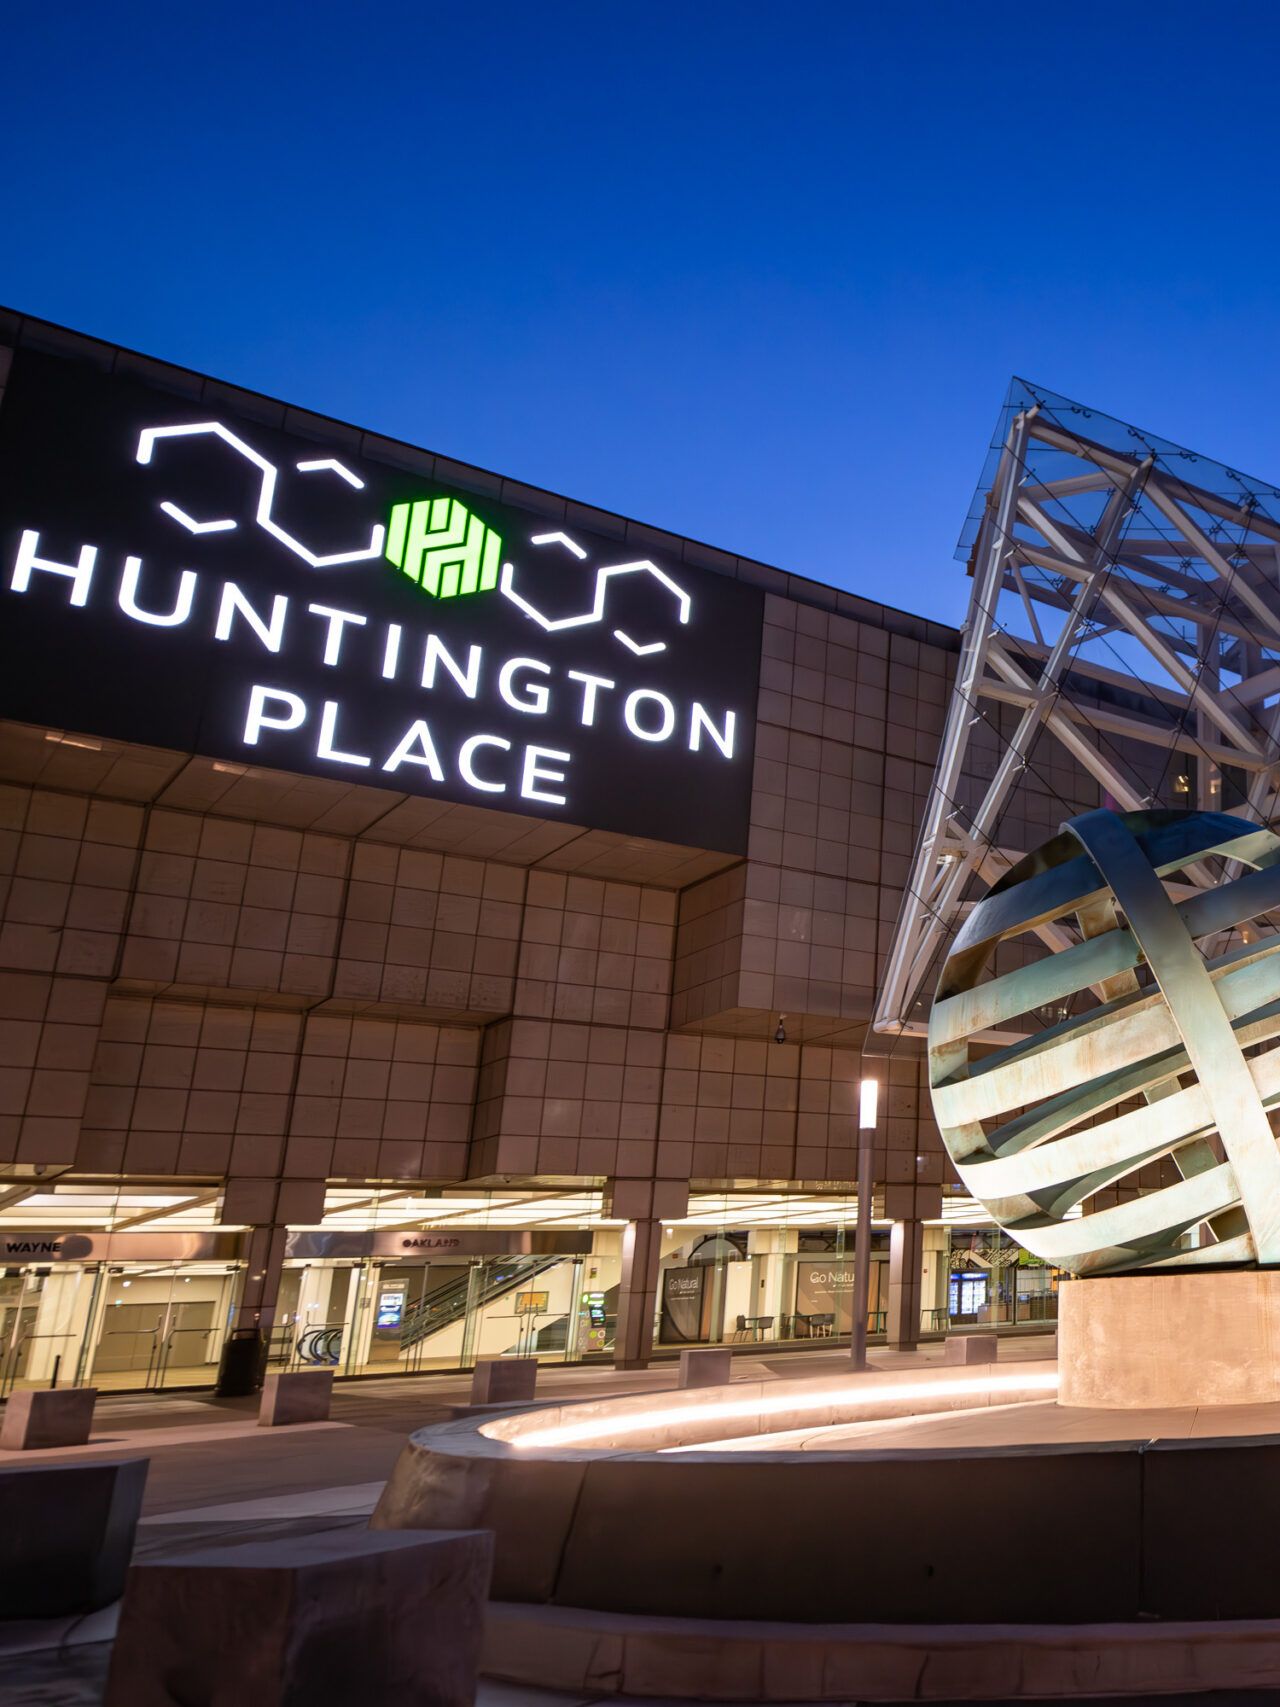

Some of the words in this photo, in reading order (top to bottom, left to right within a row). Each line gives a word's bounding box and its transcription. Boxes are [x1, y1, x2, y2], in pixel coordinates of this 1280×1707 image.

[10, 529, 736, 760] HUNTINGTON
[243, 684, 572, 805] PLACE
[6, 1242, 62, 1253] WAYNE
[809, 1271, 826, 1284] Go
[828, 1271, 855, 1283] Natu
